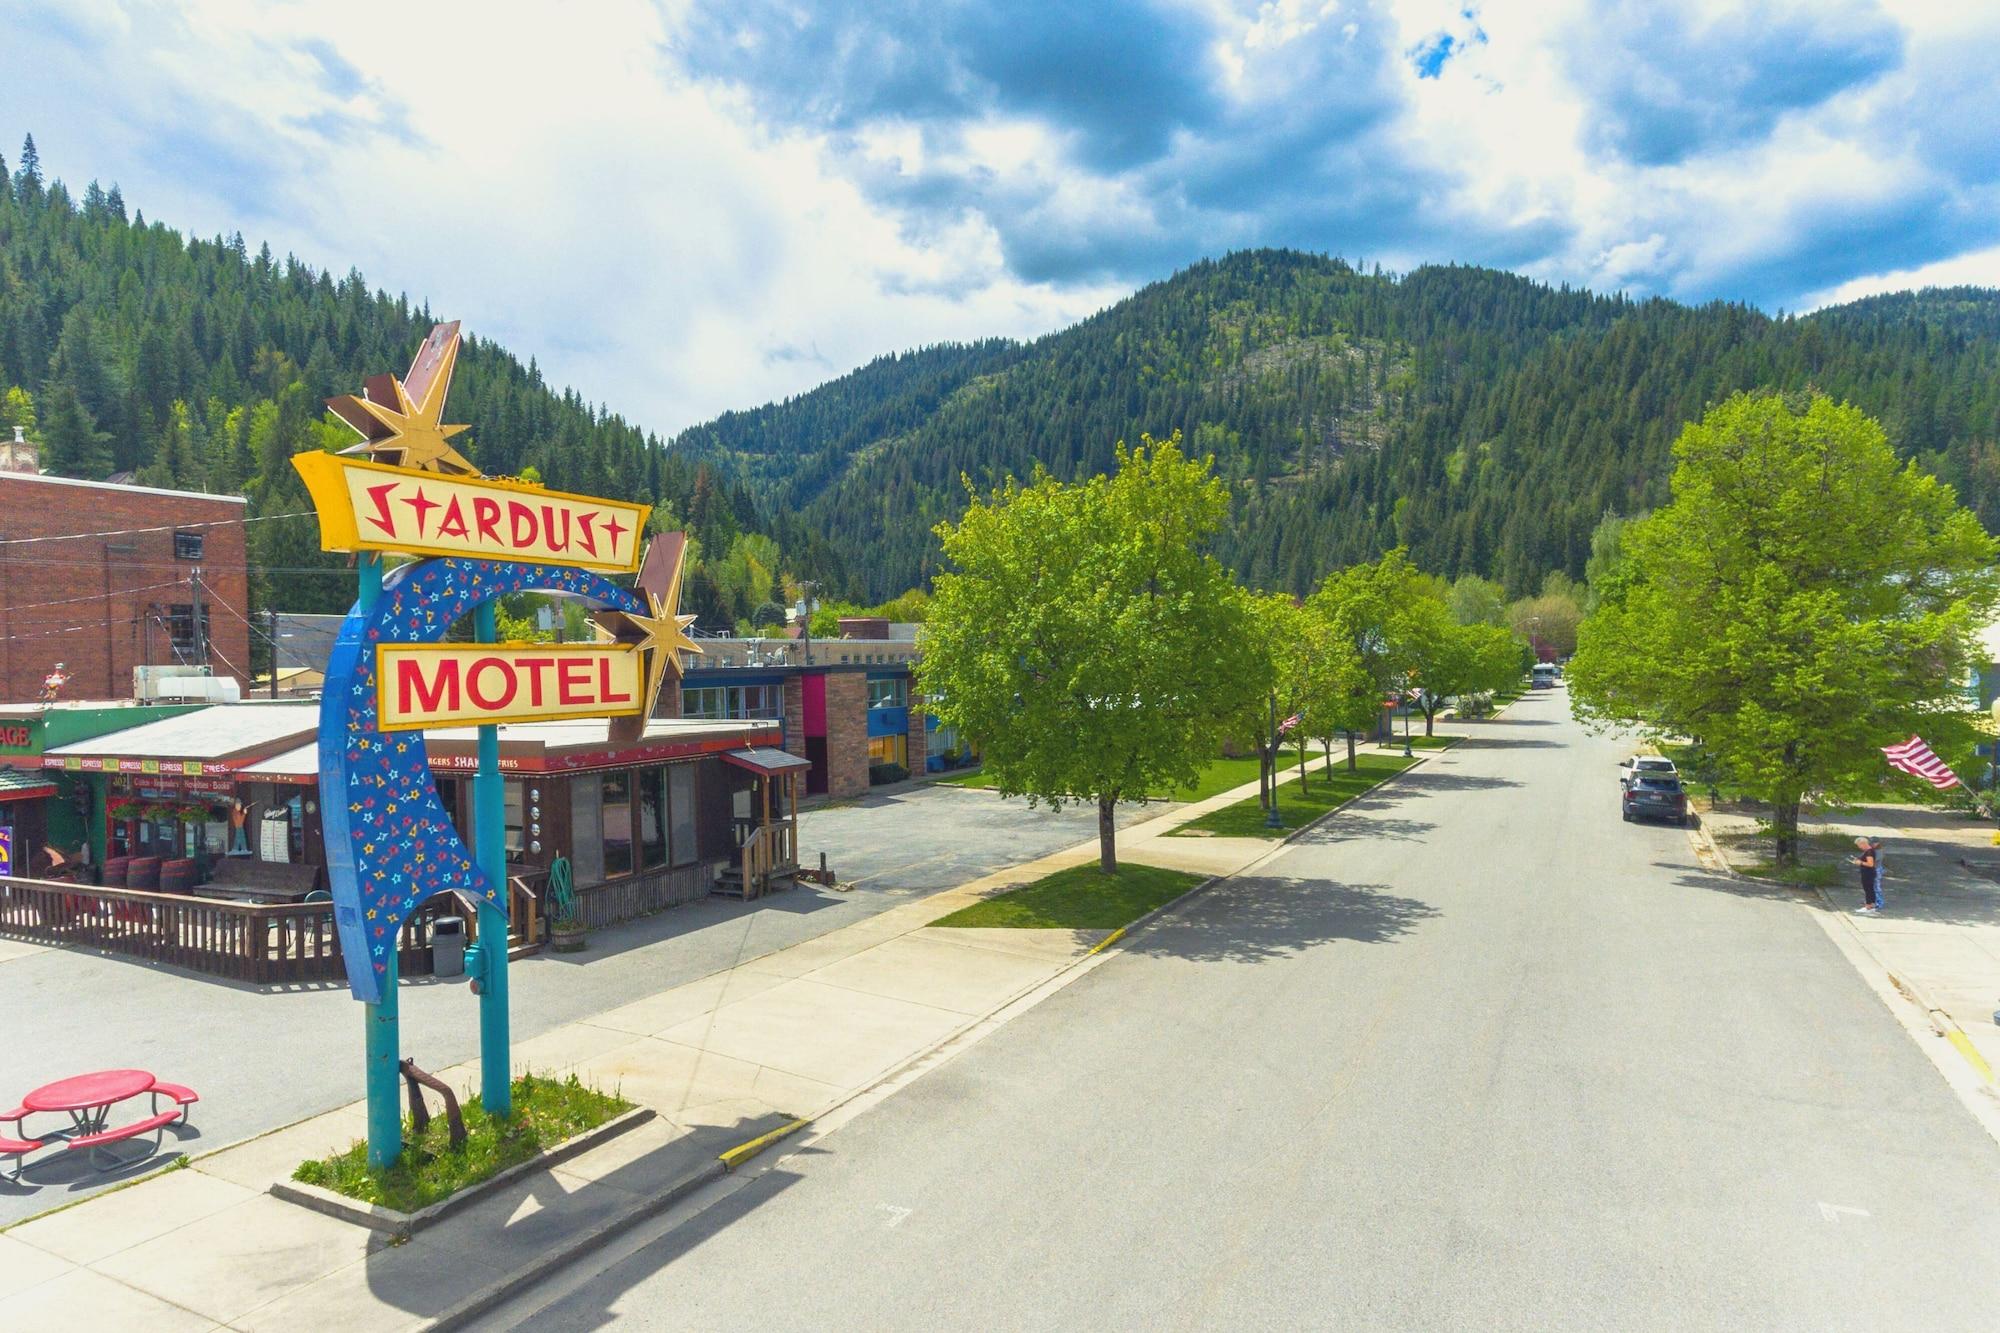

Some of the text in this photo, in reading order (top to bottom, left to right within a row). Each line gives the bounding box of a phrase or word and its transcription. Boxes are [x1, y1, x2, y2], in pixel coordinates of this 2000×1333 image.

[364, 482, 629, 559] STARDUST
[397, 656, 631, 714] MOTEL
[427, 756, 519, 769] RGERS SHAK FRIES
